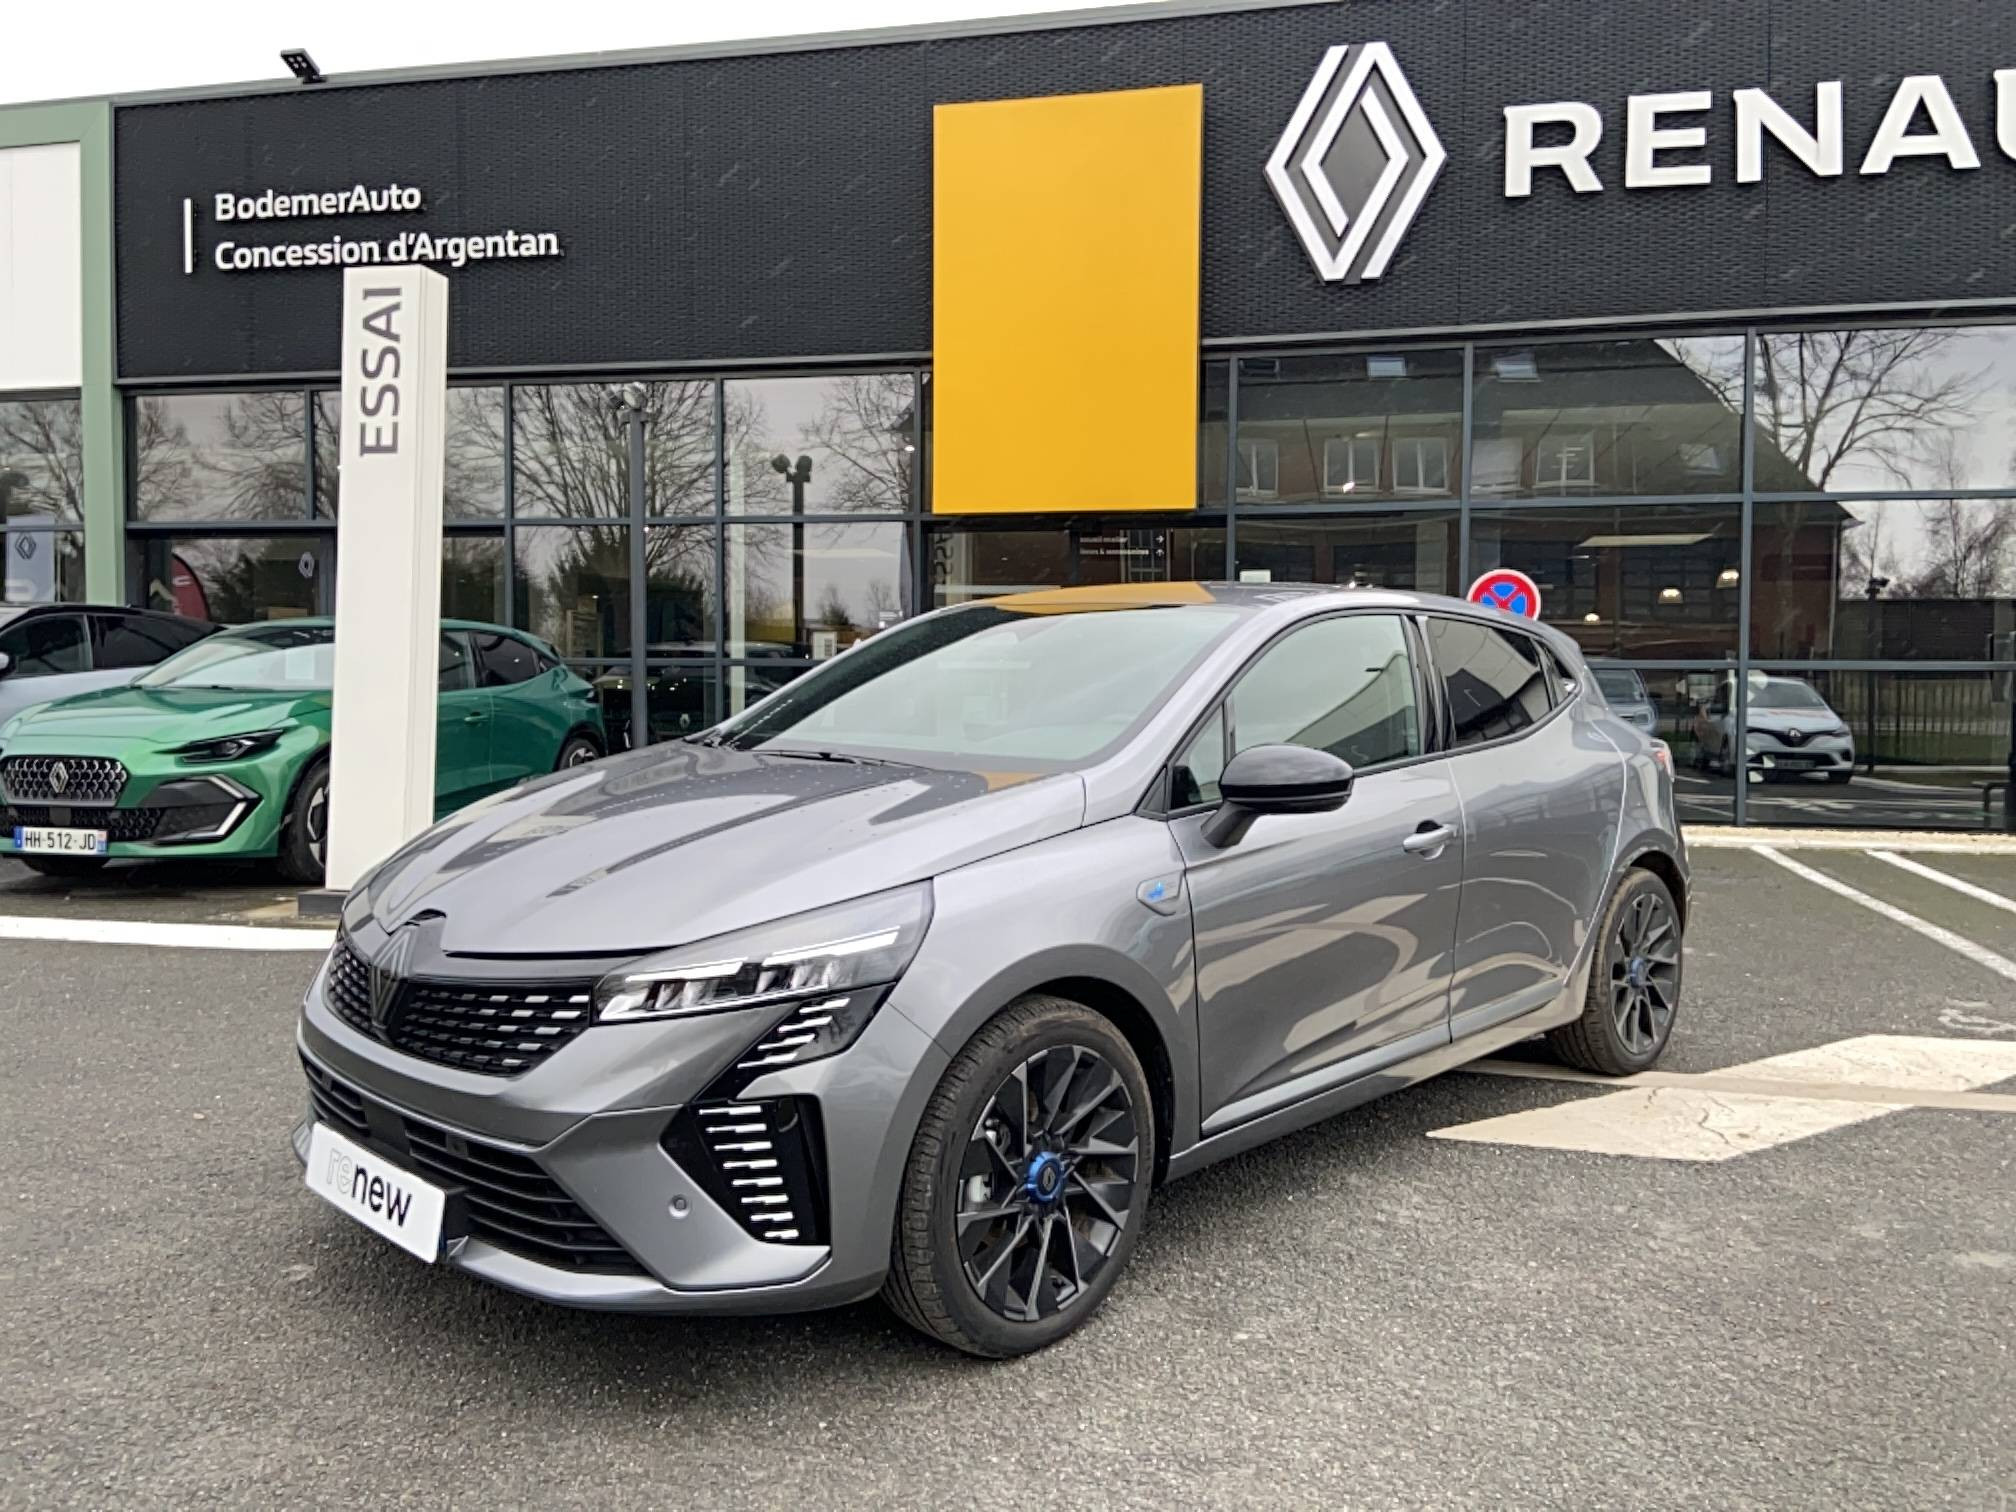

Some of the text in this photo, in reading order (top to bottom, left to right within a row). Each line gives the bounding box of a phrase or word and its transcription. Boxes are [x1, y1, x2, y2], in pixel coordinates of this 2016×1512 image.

[1503, 67, 2016, 197] RENA
[214, 184, 422, 221] BodemerAuto
[214, 229, 560, 270] Concession d'Argentan
[359, 286, 403, 457] ESSAI
[326, 1147, 413, 1227] renew
